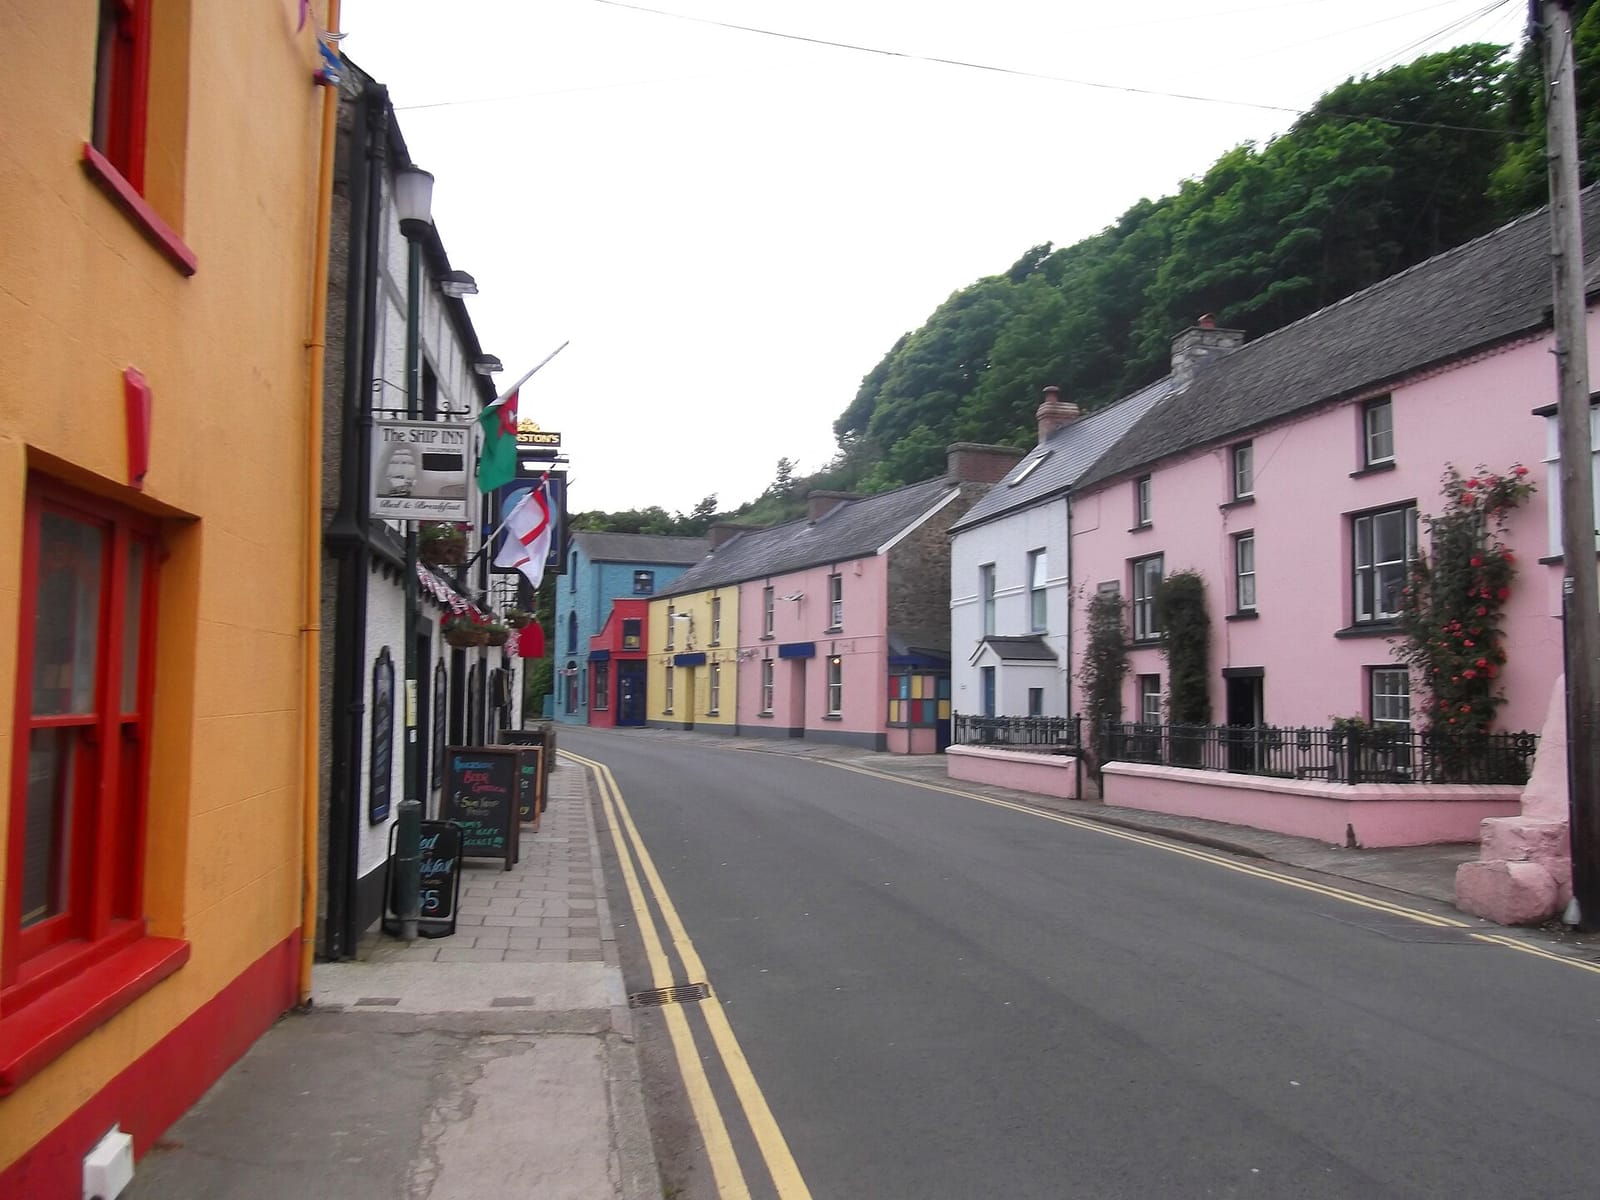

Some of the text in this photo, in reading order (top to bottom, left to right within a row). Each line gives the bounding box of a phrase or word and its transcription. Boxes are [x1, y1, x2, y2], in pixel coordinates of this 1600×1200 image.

[383, 428, 465, 445] The SHIP INN
[379, 499, 401, 508] Bed
[414, 500, 461, 513] Breakfast
[419, 832, 441, 850] ed
